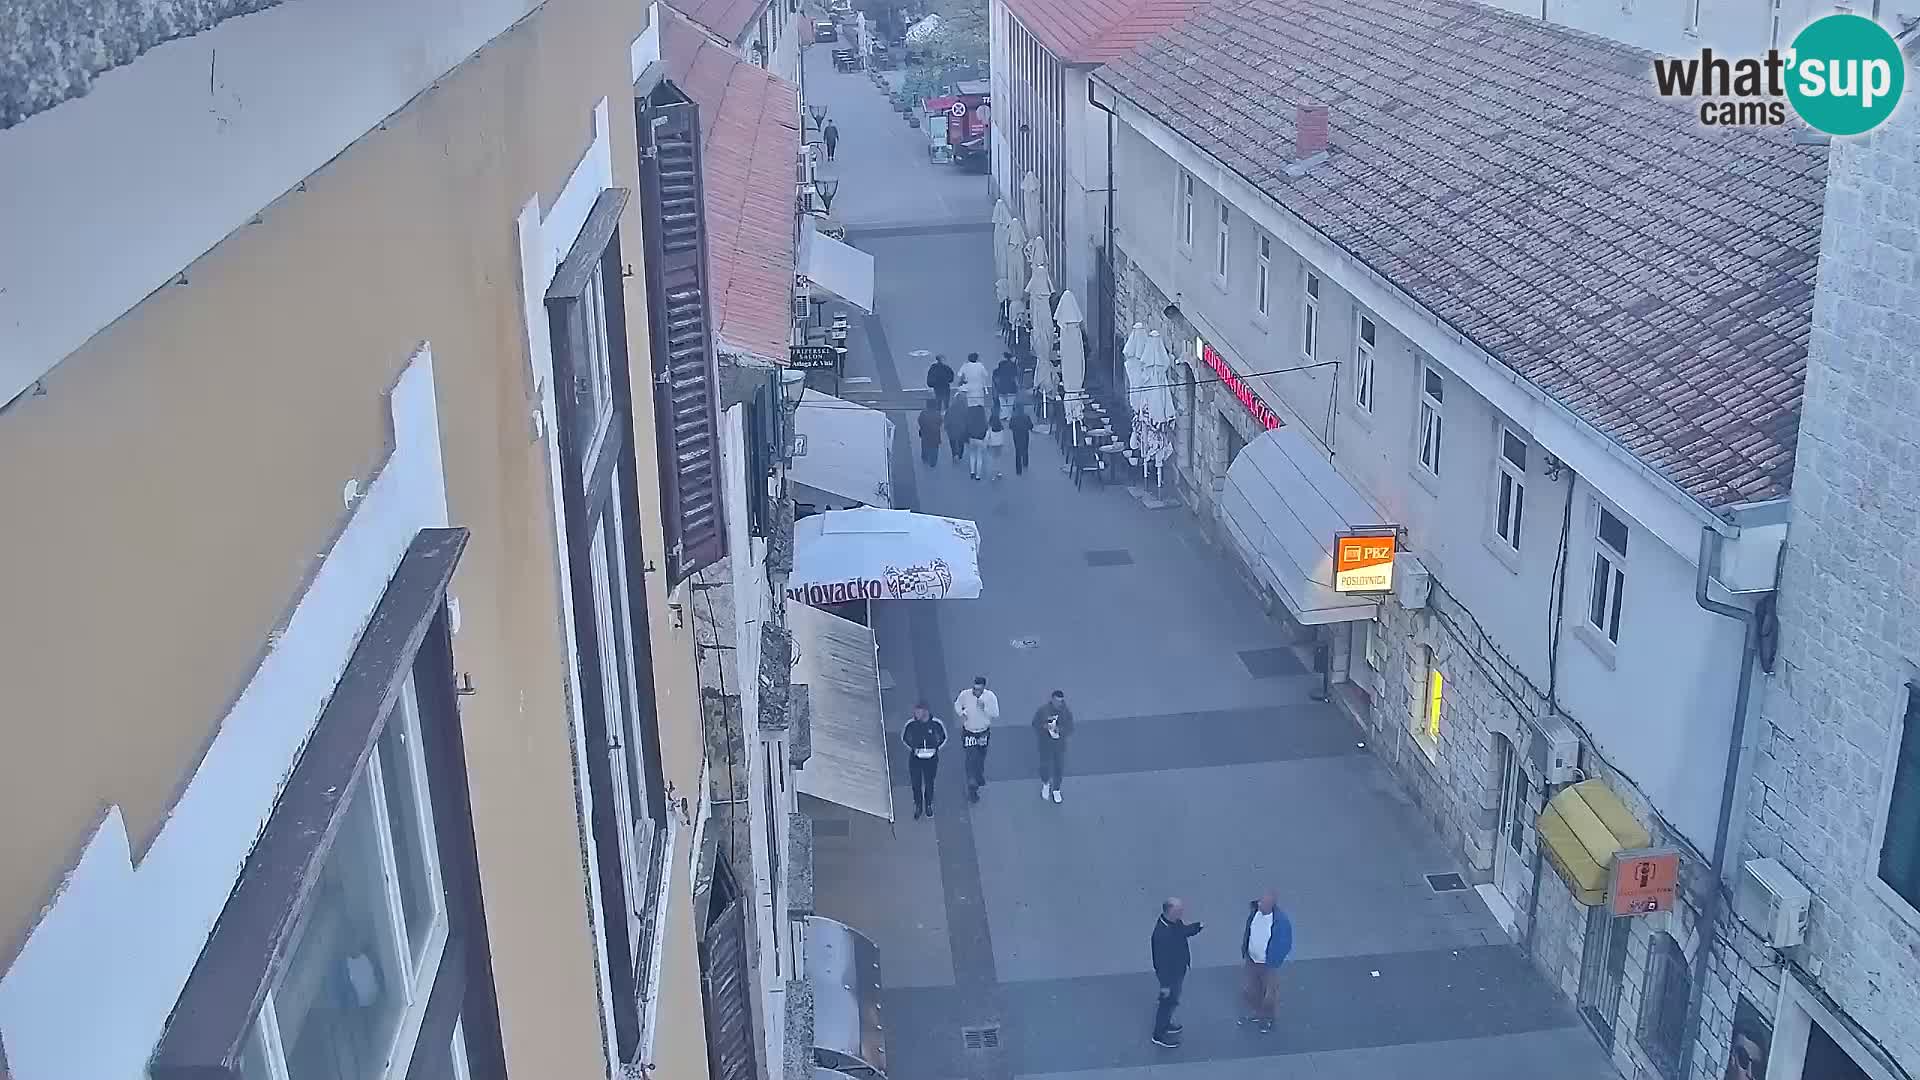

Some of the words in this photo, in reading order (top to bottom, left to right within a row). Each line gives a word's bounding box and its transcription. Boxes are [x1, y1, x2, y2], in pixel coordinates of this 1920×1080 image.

[1364, 547, 1391, 560] PBZ
[1341, 575, 1386, 586] POSLOVNICA
[786, 577, 883, 607] arlovačko
